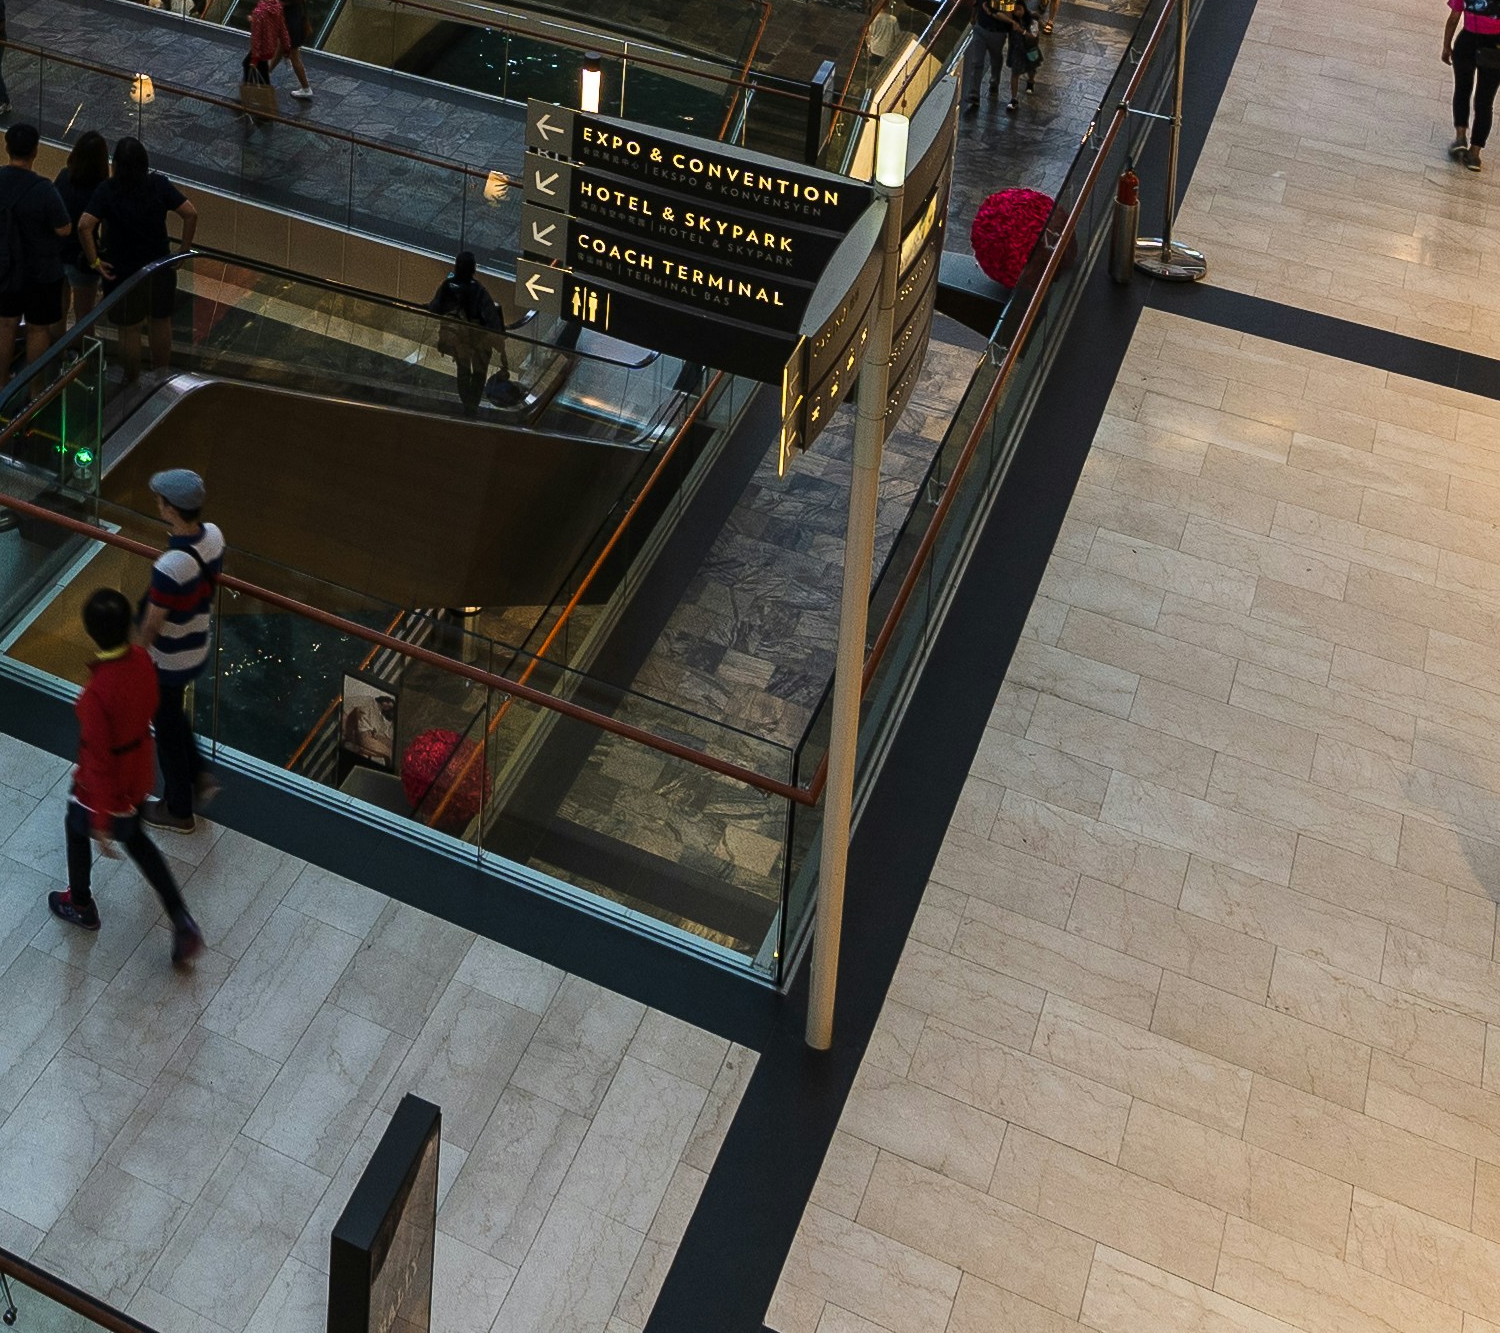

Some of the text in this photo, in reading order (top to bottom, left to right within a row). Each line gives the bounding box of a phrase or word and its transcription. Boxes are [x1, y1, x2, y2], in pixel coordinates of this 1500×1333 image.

[583, 127, 840, 207] EXPO & CONVENTION
[652, 166, 699, 187] EKSPO
[720, 185, 822, 217] KONVENSYEN
[580, 181, 793, 253] HOTEL & SKYPARK
[658, 224, 705, 246] HOTEL
[727, 241, 795, 268] SKYPARK
[578, 234, 653, 270] COACH
[662, 260, 785, 307] TERMINAL
[627, 269, 731, 307] TERMINAL BAS
